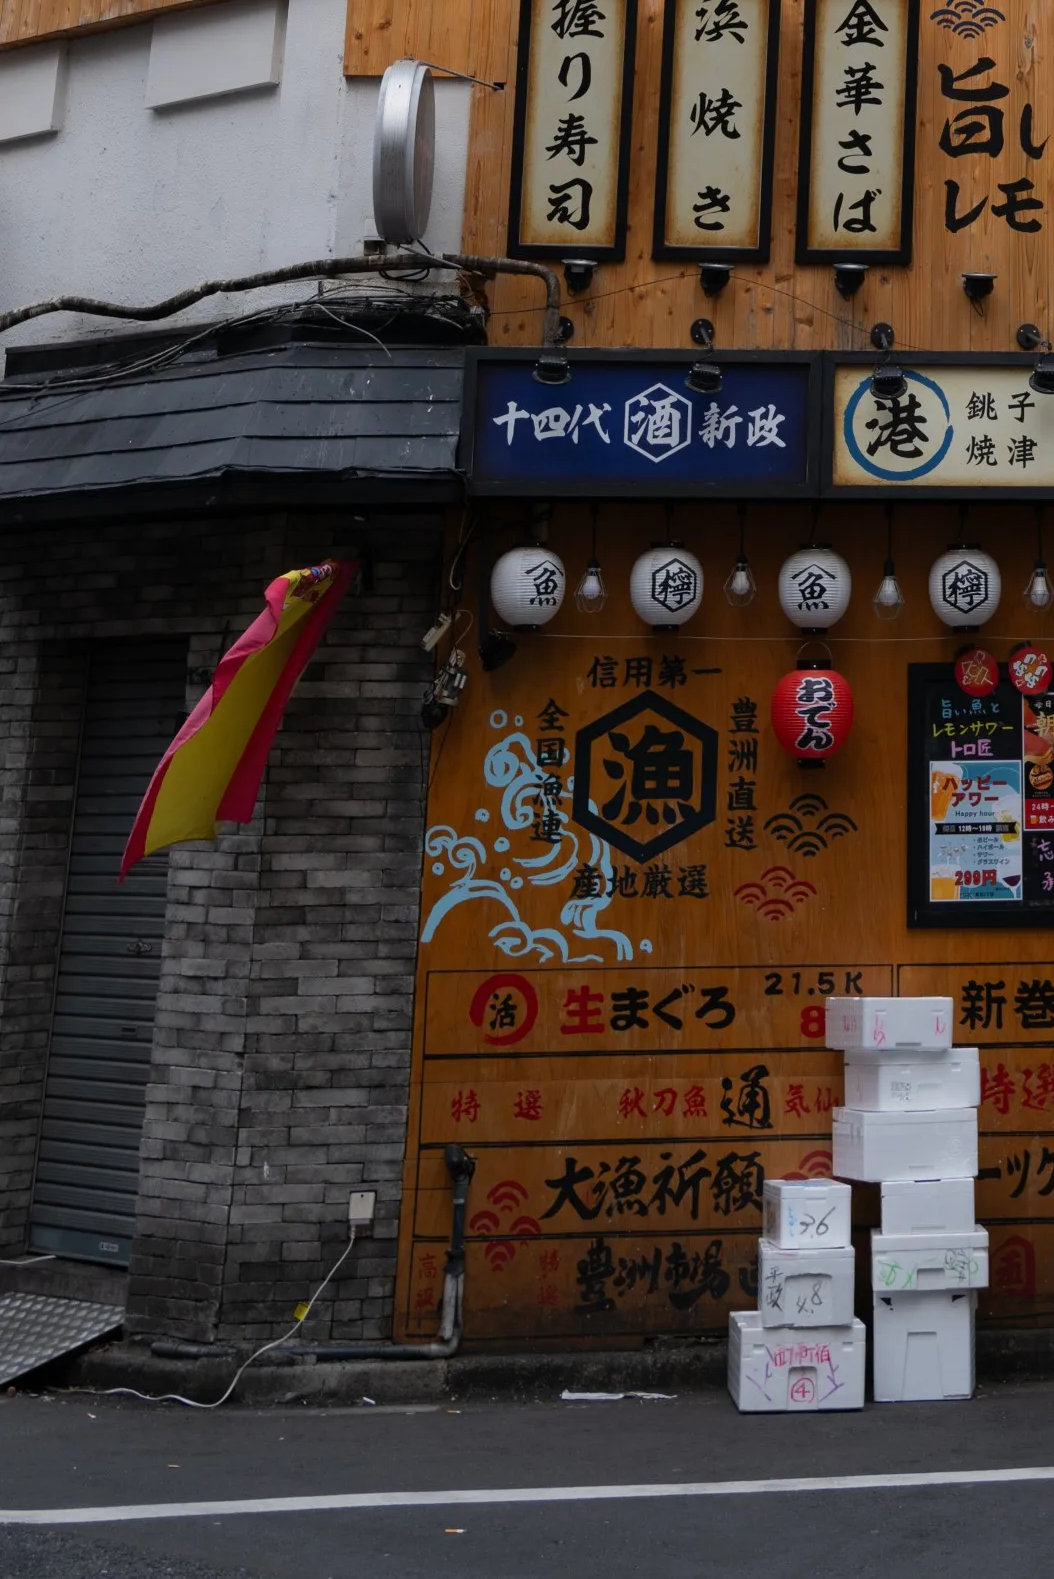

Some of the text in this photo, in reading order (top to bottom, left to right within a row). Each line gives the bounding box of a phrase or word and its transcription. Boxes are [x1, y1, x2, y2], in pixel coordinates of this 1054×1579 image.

[492, 401, 611, 447] 十四代
[630, 395, 681, 444] 酒
[699, 403, 787, 449] 新政
[964, 390, 1035, 423] 銚子
[865, 397, 930, 459] 港
[964, 435, 1038, 468] 焼津
[587, 655, 723, 689] 信用第一
[794, 675, 837, 751] おでん
[932, 721, 1016, 738] レモンサワー
[950, 738, 995, 759] トロ匠
[529, 698, 571, 844] 全国漁連
[601, 725, 702, 826] 漁
[724, 696, 760, 851] 豊洲直送
[942, 774, 1007, 792] ハッピー
[951, 792, 999, 808] アワー
[955, 810, 977, 818] Happy
[570, 863, 711, 900] 産地厳選
[618, 1085, 709, 1120] 秋刀魚
[720, 1064, 774, 1129] 通
[539, 1147, 765, 1221] 大漁祈願
